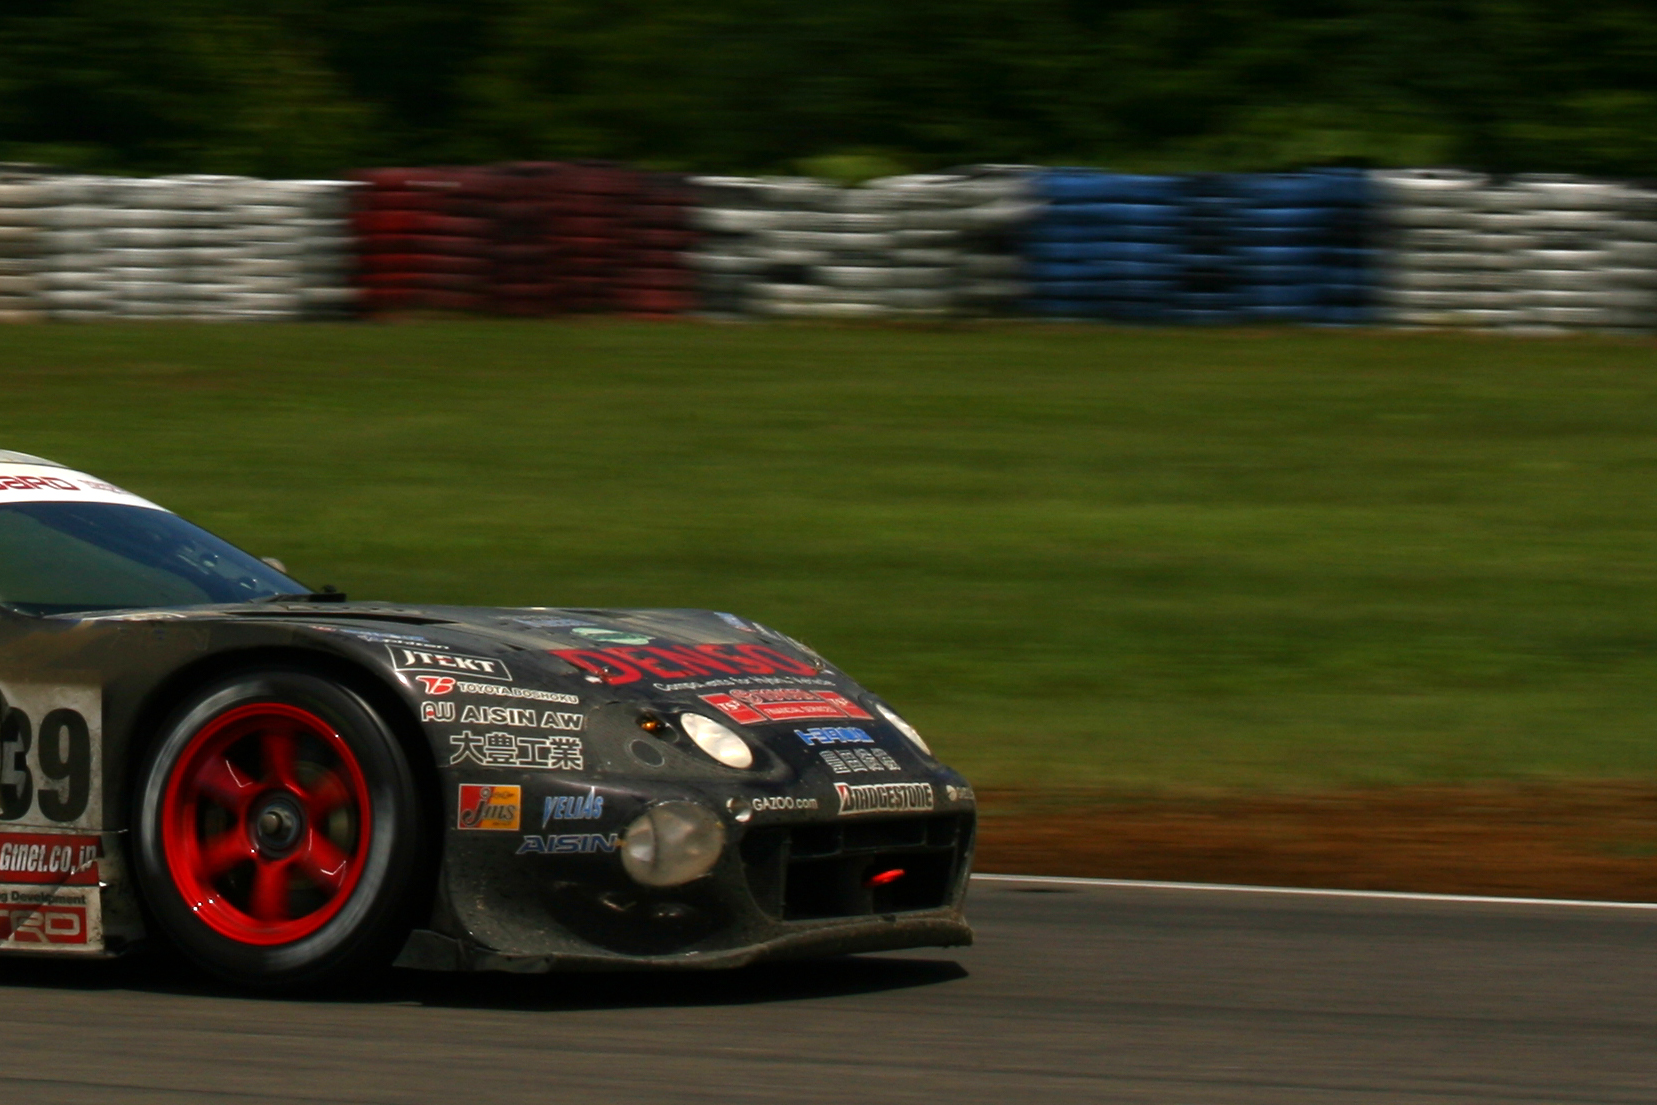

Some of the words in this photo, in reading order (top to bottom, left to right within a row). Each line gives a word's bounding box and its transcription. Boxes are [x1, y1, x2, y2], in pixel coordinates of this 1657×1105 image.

[402, 649, 495, 673] JTEKT
[547, 643, 821, 685] DENSO
[457, 681, 513, 697] TOYOTA
[512, 687, 579, 704] BOSHOKU
[460, 705, 537, 727] AISIN
[540, 712, 584, 730] AW
[449, 730, 584, 770] 大豊工業
[752, 796, 819, 812] GAZOO.com
[834, 782, 934, 814] BRIDGESTONE
[515, 833, 618, 855] AISIN
[11, 890, 87, 905] Development
